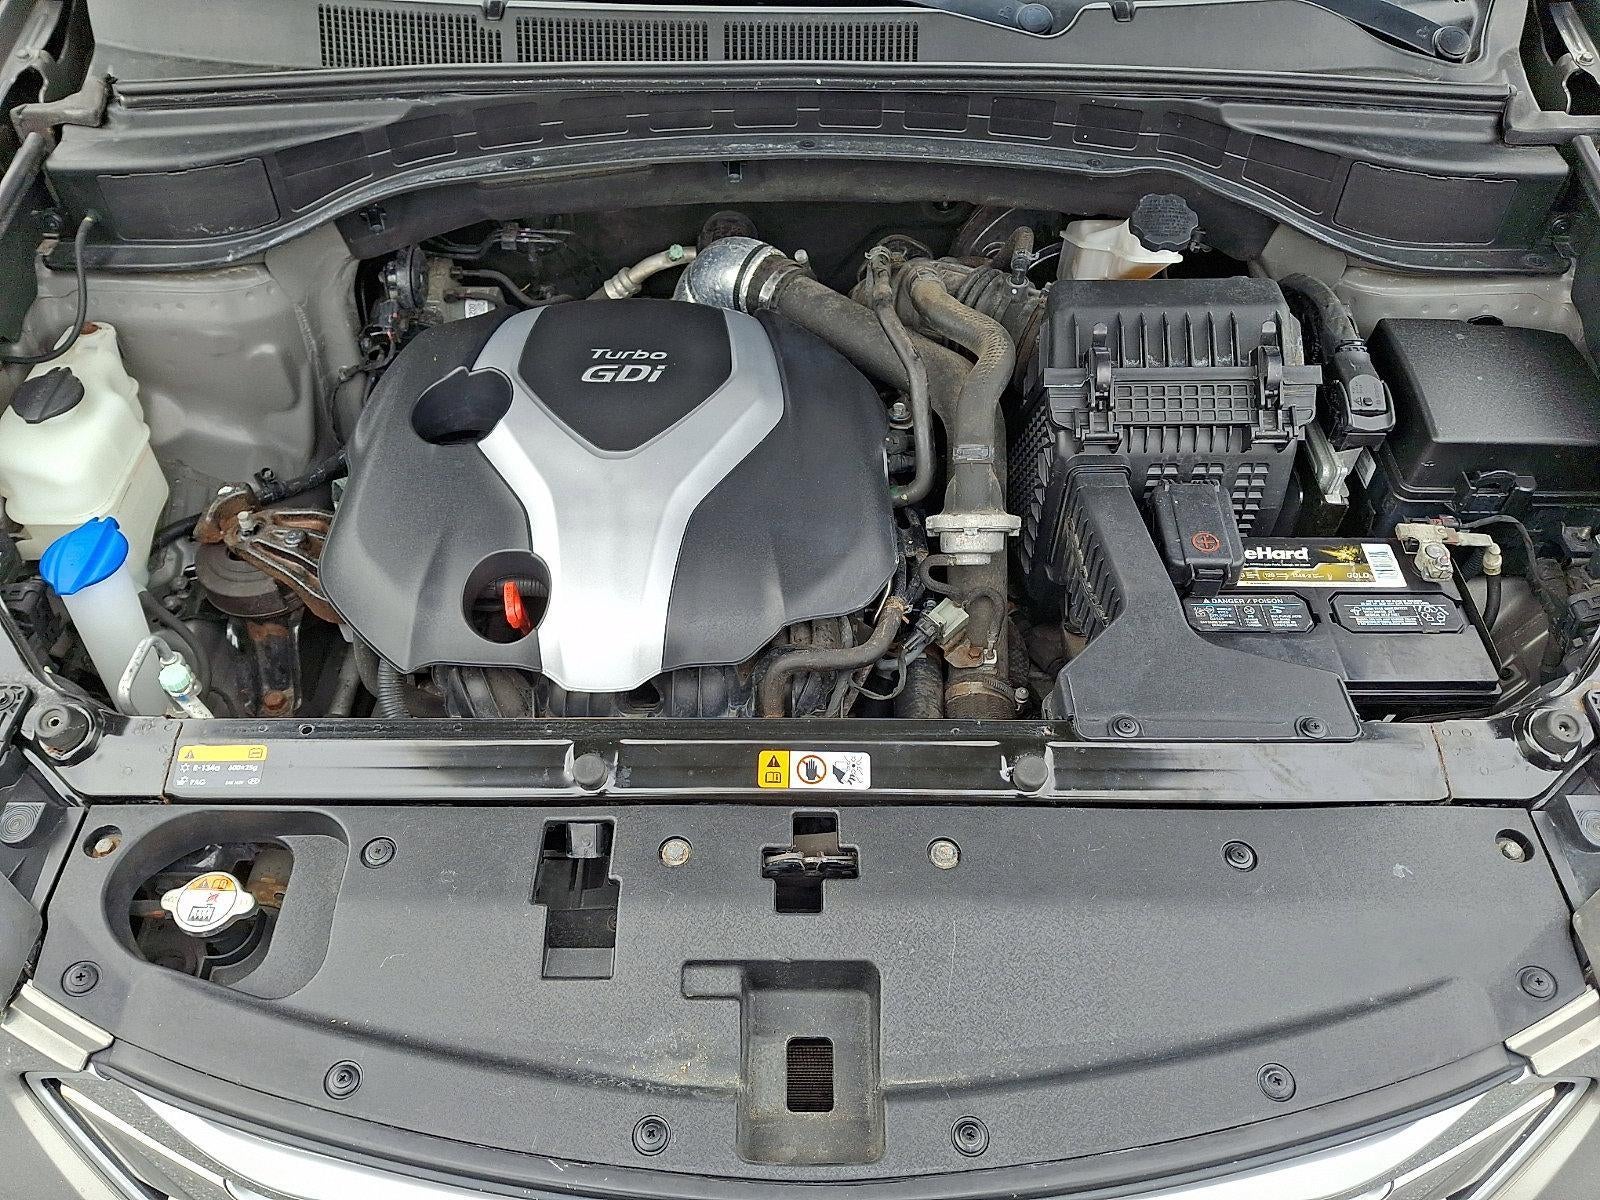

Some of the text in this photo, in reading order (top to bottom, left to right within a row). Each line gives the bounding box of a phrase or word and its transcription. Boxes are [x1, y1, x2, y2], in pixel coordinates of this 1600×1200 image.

[591, 348, 668, 360] Turbo
[581, 364, 668, 383] GDi
[1243, 546, 1309, 561] eHard
[192, 764, 221, 772] R-134a
